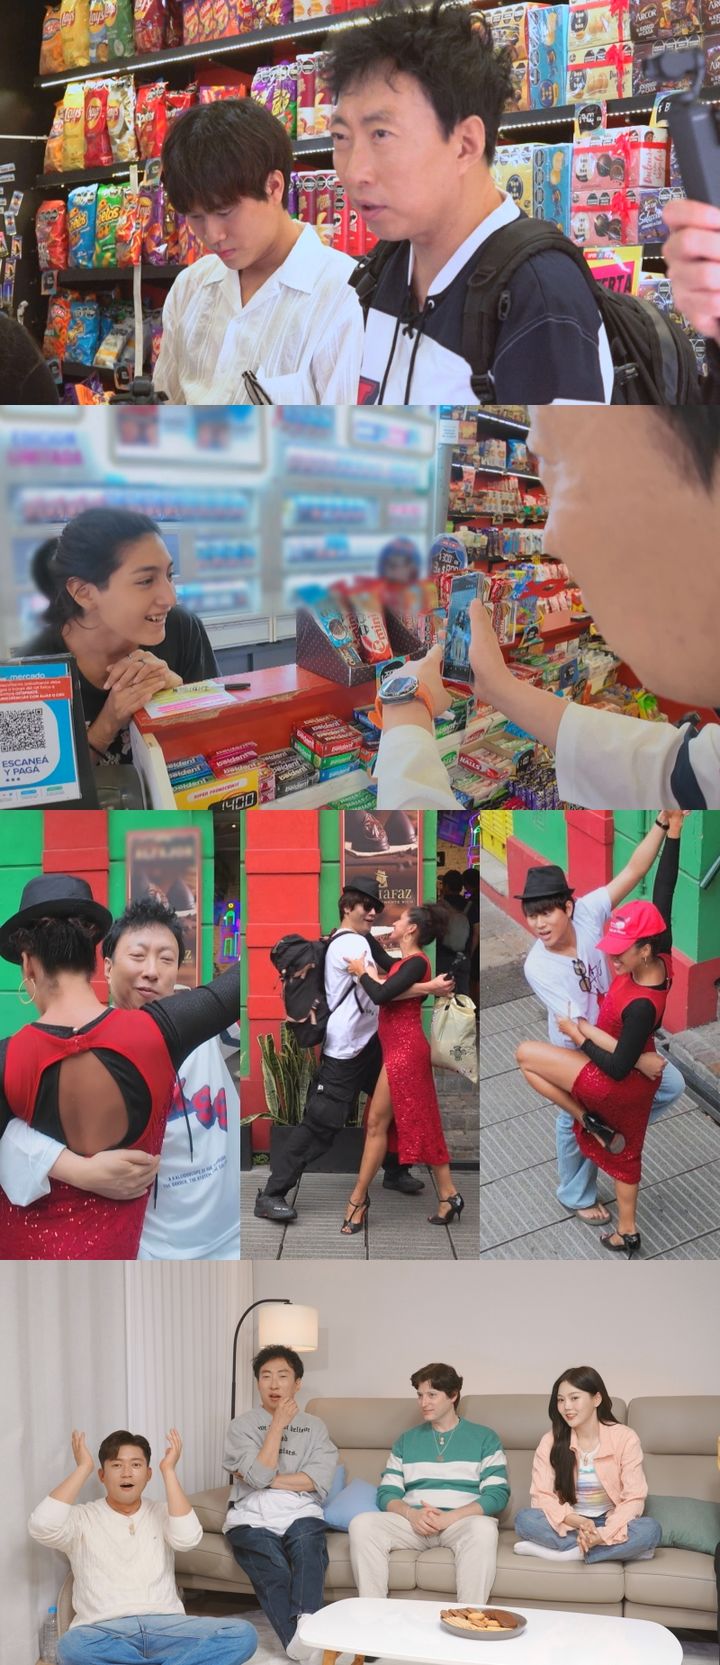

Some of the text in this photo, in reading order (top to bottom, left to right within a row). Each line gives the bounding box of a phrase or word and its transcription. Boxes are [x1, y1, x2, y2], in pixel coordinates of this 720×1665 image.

[2, 756, 49, 768] ESCANEÁ
[460, 756, 481, 770] HALLS
[13, 765, 40, 776] PAGÁ
[221, 792, 255, 810] 1400
